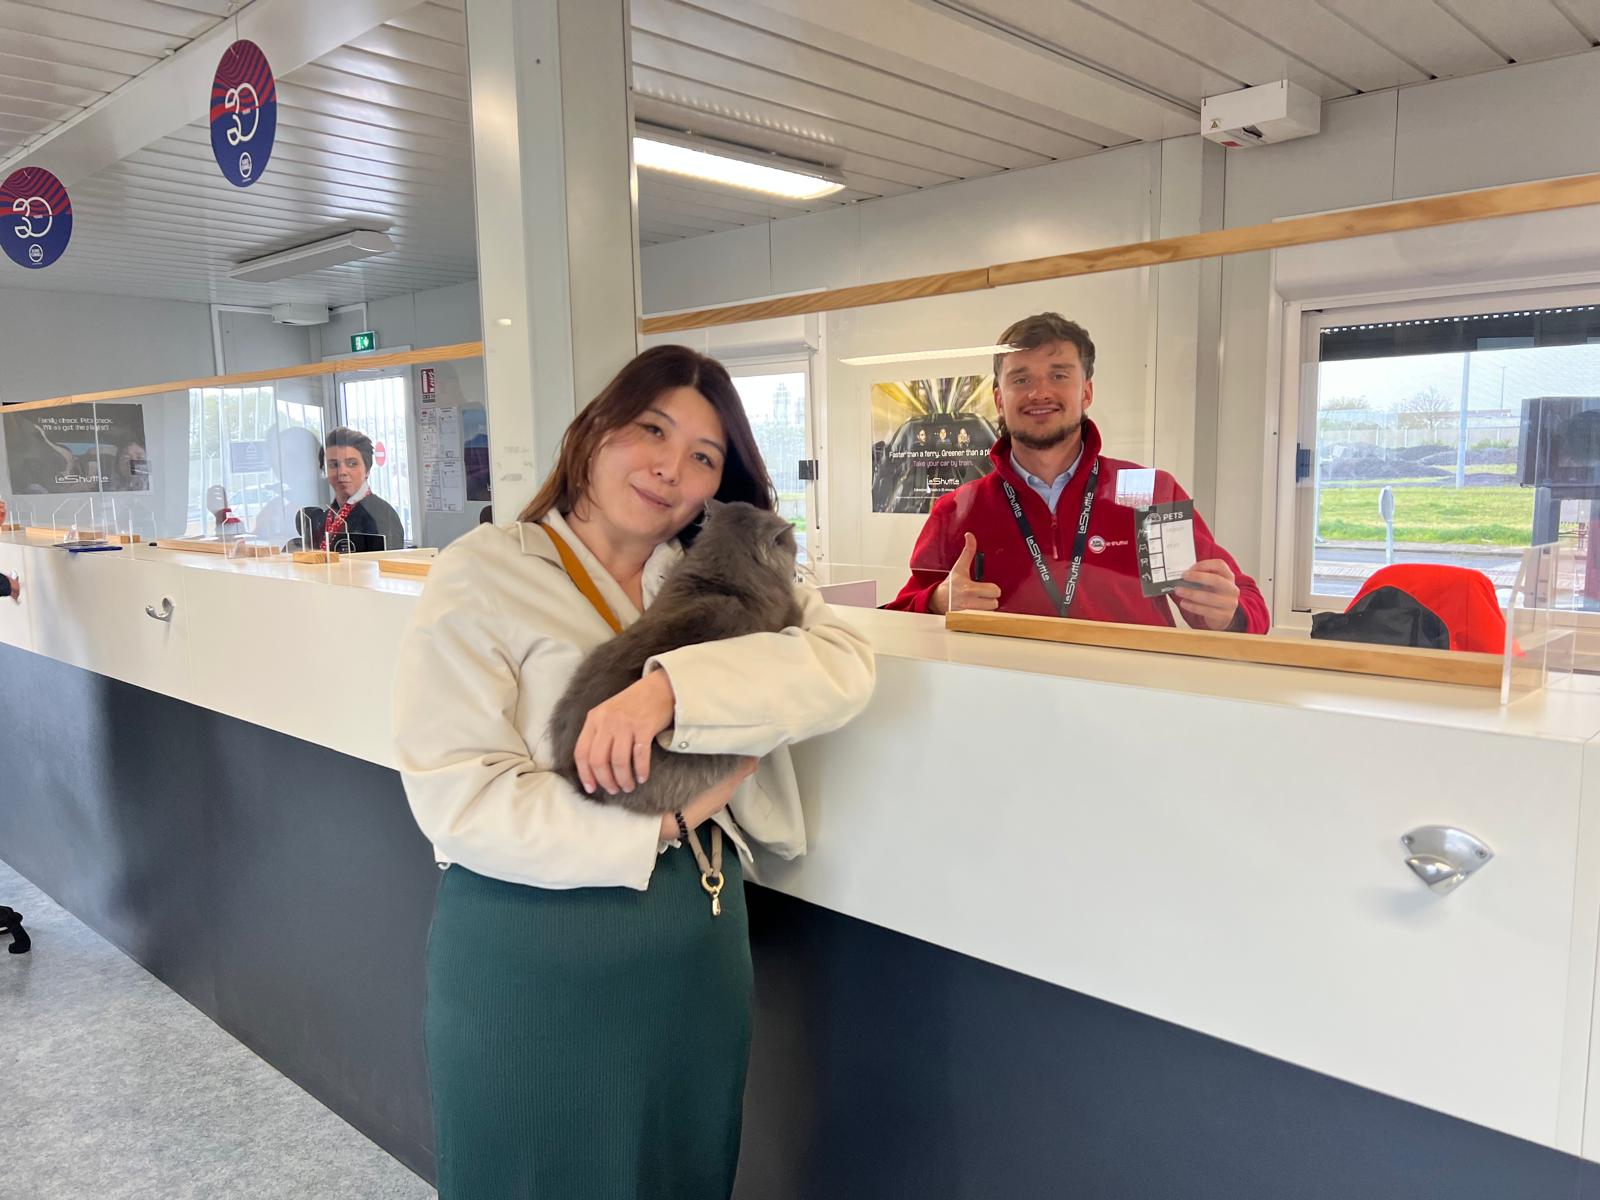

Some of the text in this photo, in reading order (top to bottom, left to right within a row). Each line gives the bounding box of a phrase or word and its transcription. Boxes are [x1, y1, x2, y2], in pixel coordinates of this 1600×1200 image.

[925, 450, 940, 459] ferry.
[941, 449, 966, 457] Greener
[913, 460, 926, 468] Take
[926, 460, 939, 469] your
[950, 459, 958, 468] by
[1163, 512, 1184, 521] PETS
[1025, 535, 1050, 582] LeShuttle
[1064, 556, 1081, 605] LeShuttle
